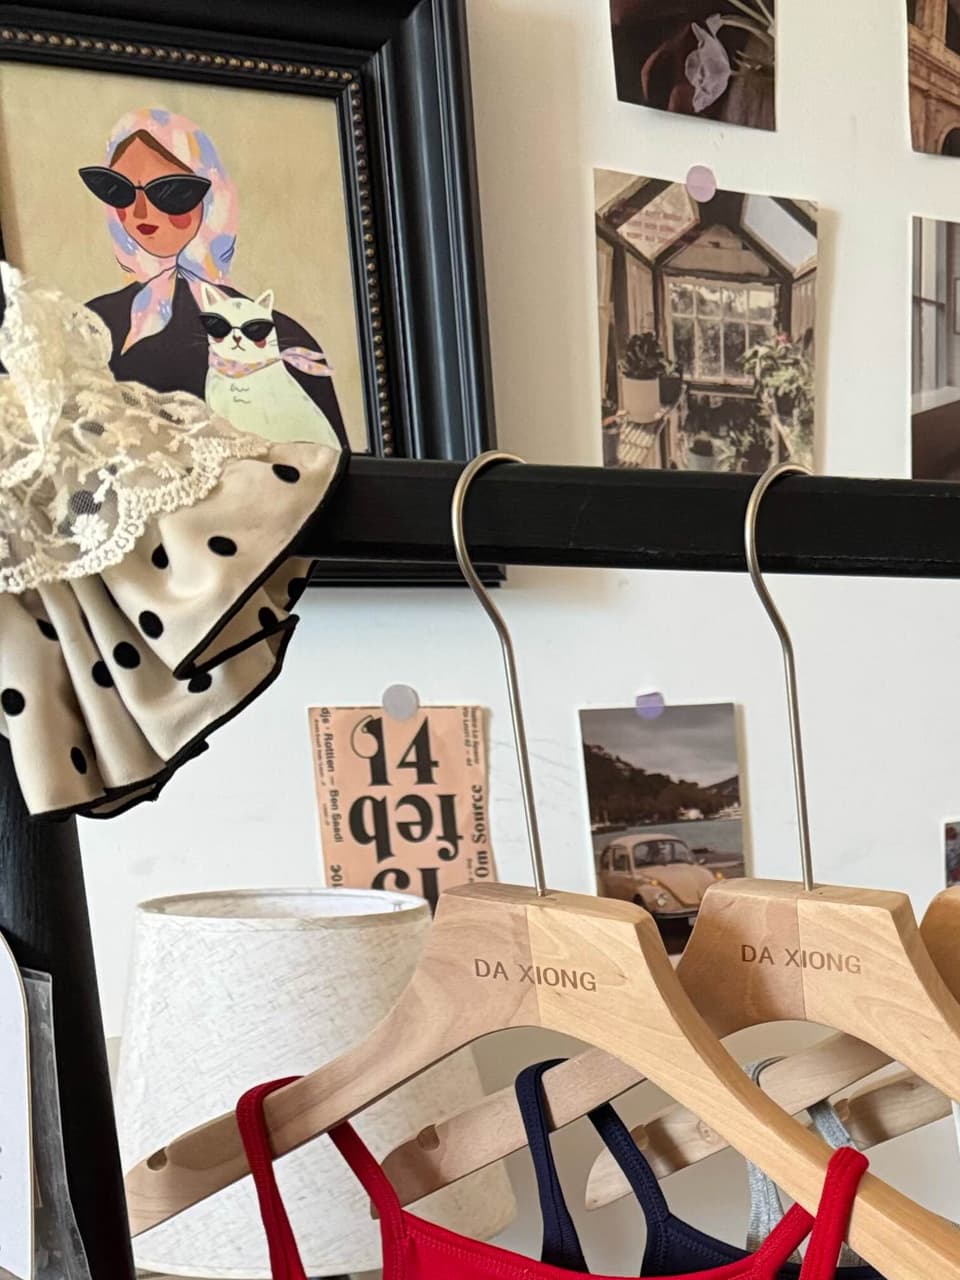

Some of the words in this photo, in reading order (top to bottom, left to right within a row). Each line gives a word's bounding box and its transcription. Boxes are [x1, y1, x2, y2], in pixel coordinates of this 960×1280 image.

[351, 715, 440, 787] 14
[474, 958, 509, 982] DA
[518, 963, 597, 992] XIONG
[740, 944, 775, 965] DA
[784, 948, 862, 975] XIONG
